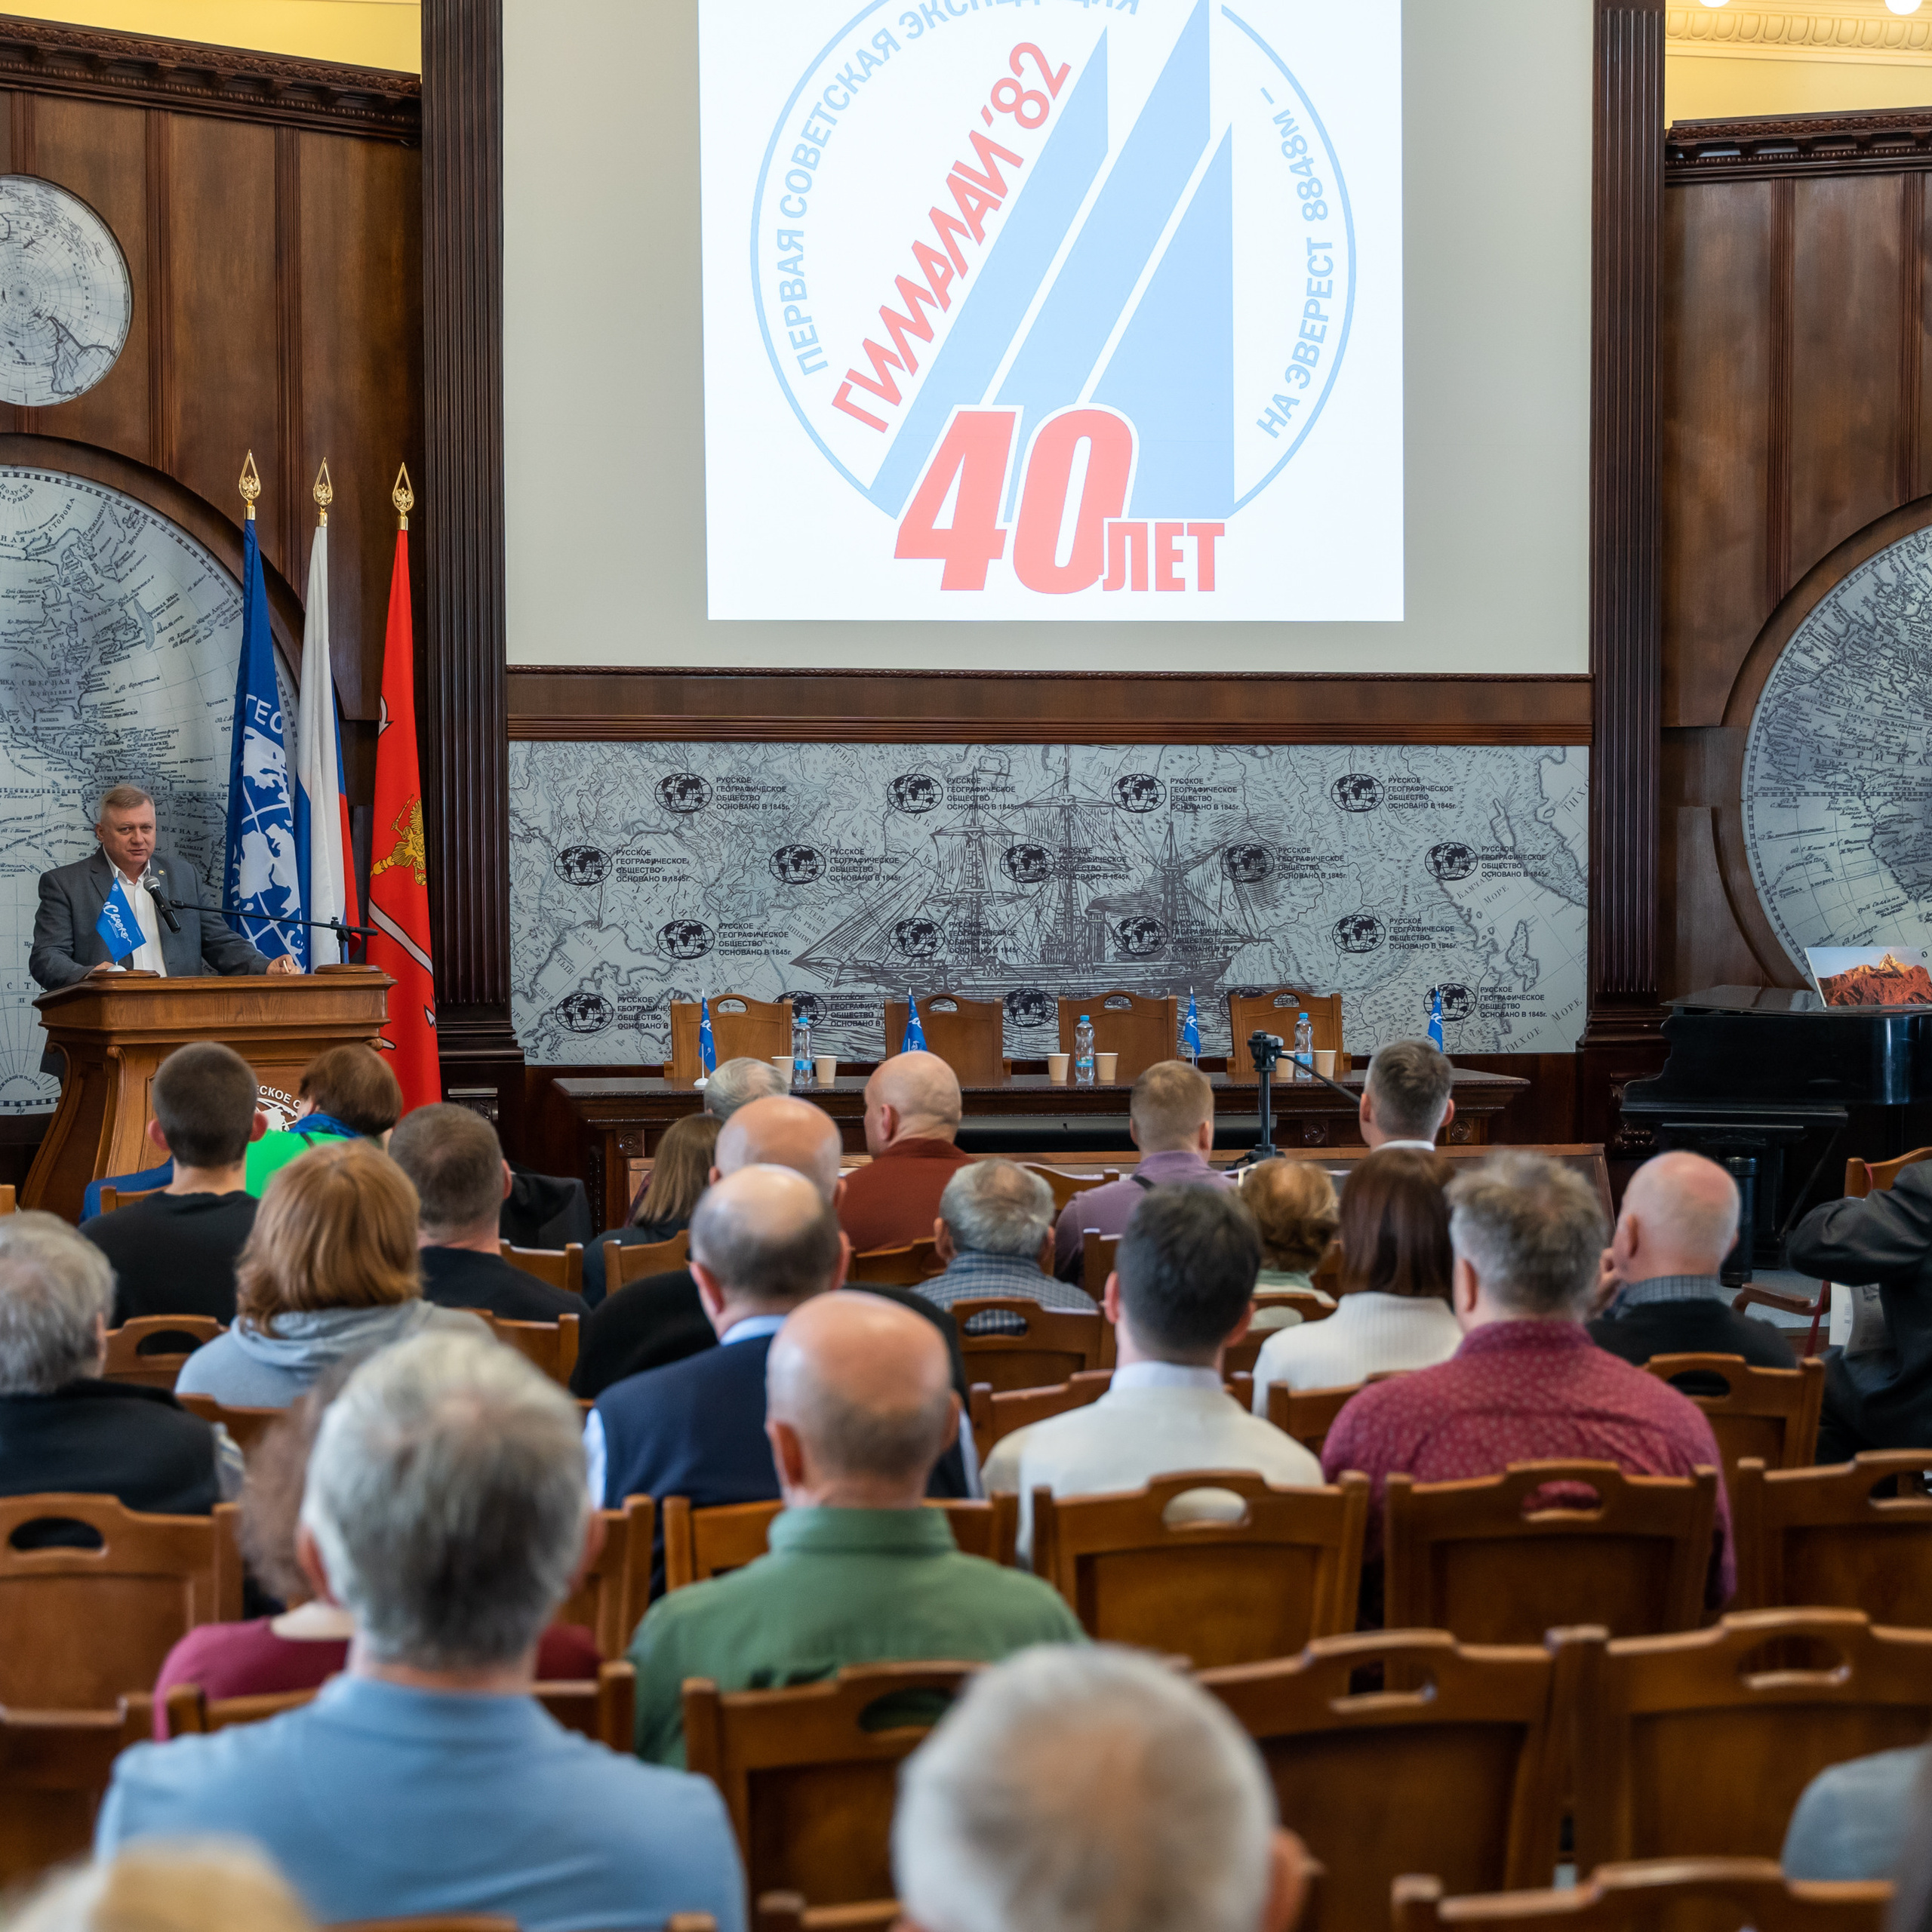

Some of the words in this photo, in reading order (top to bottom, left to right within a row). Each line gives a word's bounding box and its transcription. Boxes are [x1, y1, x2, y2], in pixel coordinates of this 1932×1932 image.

[780, 28, 901, 219] СОВЕТСКАЯ
[777, 229, 829, 375] ПЕРВАЯ
[1257, 393, 1300, 438] НА
[1284, 237, 1334, 389] ЭВЕРЕСТ
[894, 409, 1133, 594] 40
[1103, 521, 1226, 592] ЛЕТ
[245, 694, 283, 734] ГЕО
[831, 744, 855, 768] ЕРНІЯ
[1811, 744, 1924, 766] АФРИКА
[1483, 884, 1509, 906] МОРЕ
[1552, 998, 1583, 1022] МОРЕ
